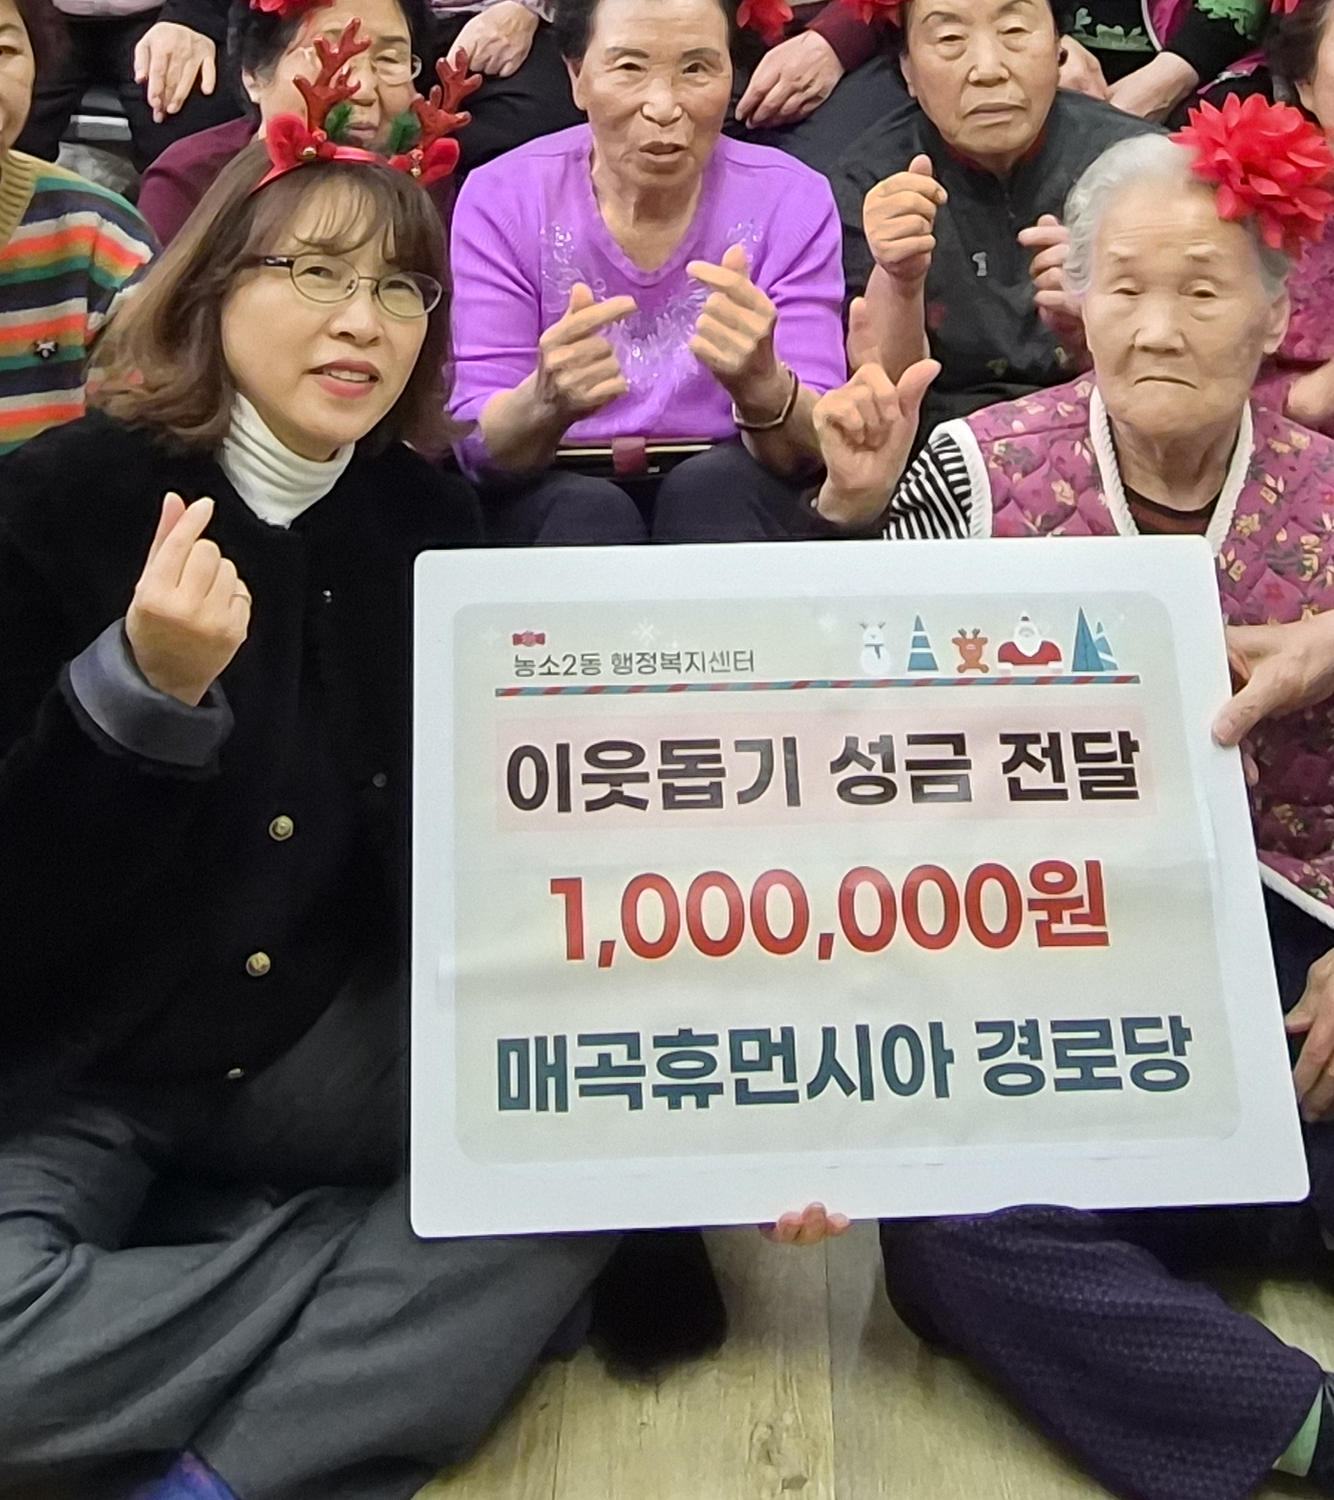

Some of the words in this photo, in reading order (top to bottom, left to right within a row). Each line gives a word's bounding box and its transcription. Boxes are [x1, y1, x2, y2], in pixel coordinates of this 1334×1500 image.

[513, 652, 602, 678] 농소2동
[610, 649, 756, 676] 행정복지센터
[505, 736, 803, 814] 이웃돕기
[829, 731, 973, 805] 성금
[998, 729, 1141, 802] 전달
[549, 859, 1111, 969] 1,000,000원
[496, 1020, 956, 1113] 매곡휴먼시아
[974, 1014, 1193, 1098] 경로당
